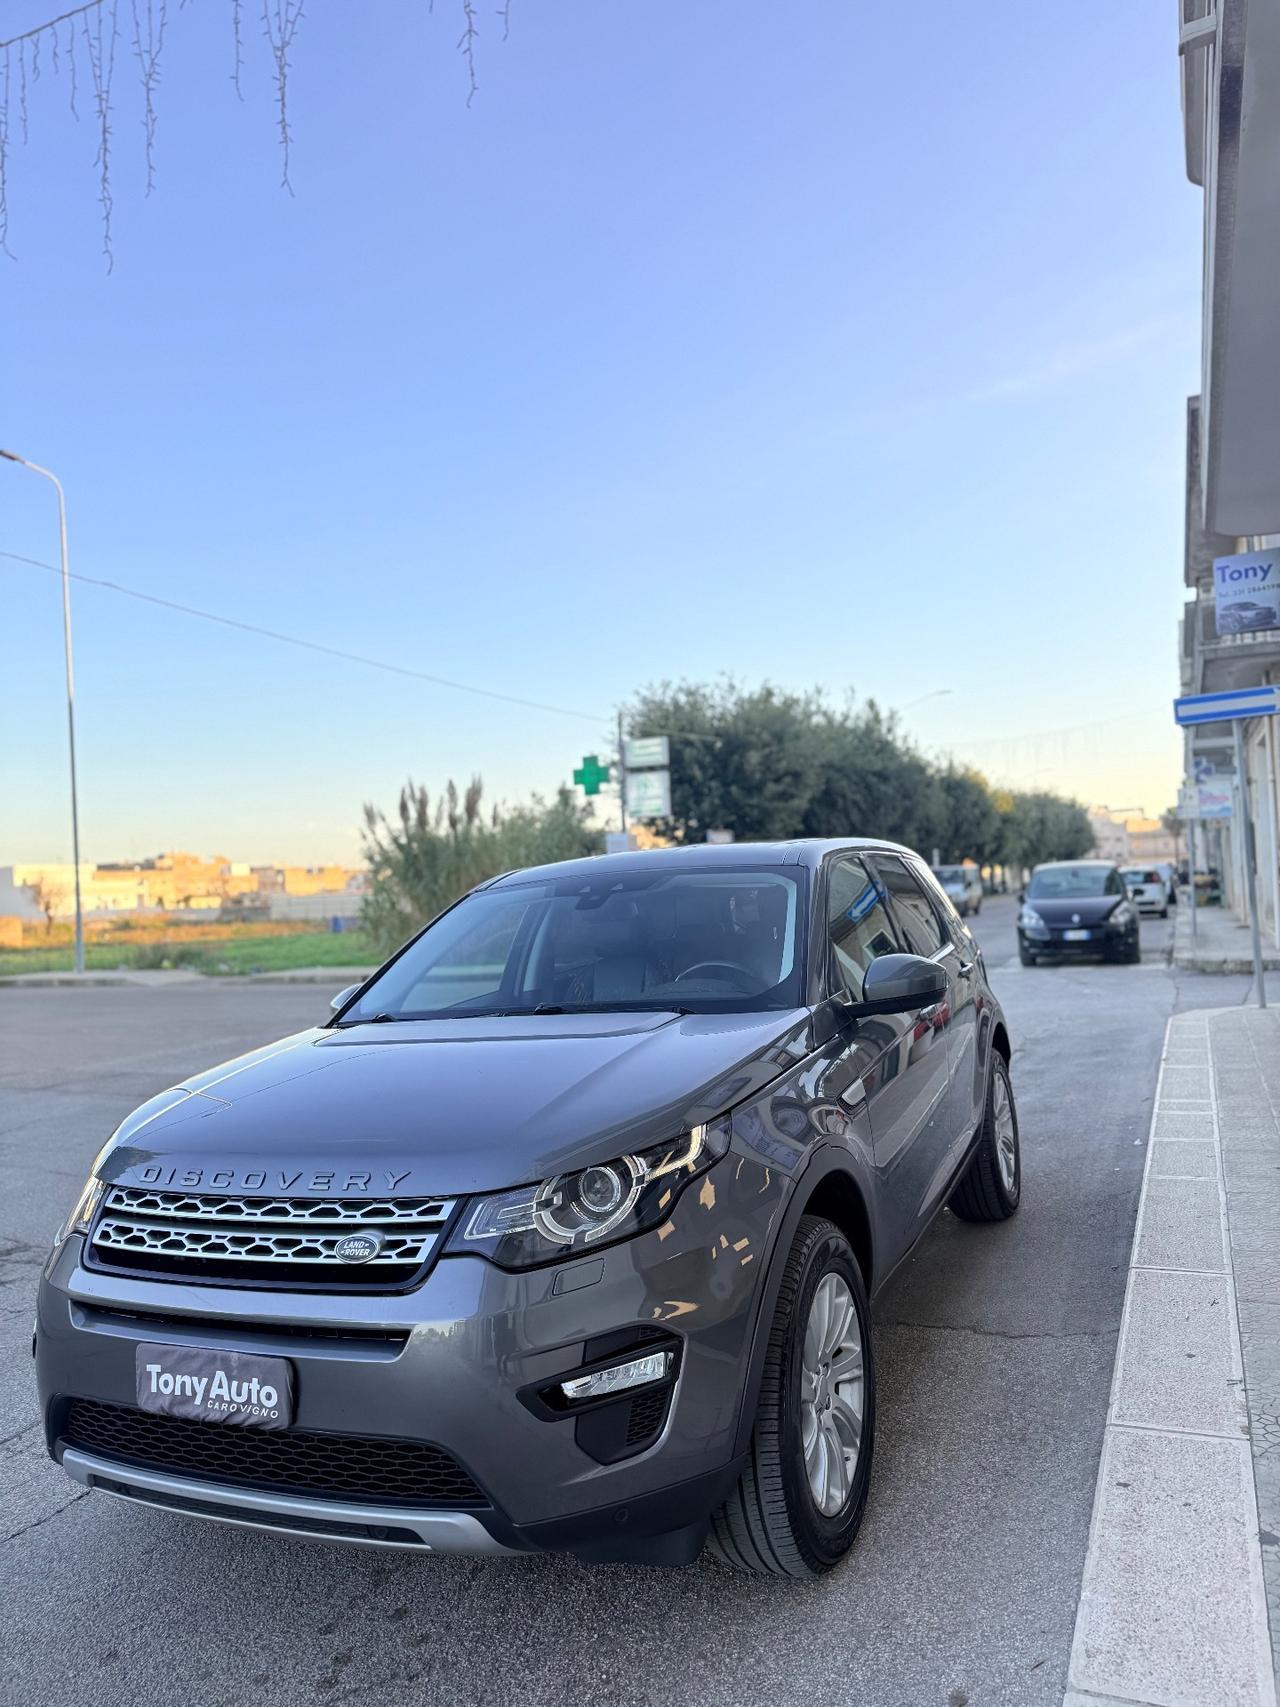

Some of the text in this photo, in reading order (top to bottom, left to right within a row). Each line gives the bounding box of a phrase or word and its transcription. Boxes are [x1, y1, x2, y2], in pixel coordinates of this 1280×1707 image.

[1216, 563, 1273, 583] Tony
[139, 1164, 412, 1192] DISCOVERY
[343, 1240, 365, 1248] LAND
[344, 1248, 371, 1256] ROVER
[207, 1399, 279, 1420] CAROVIGNO
